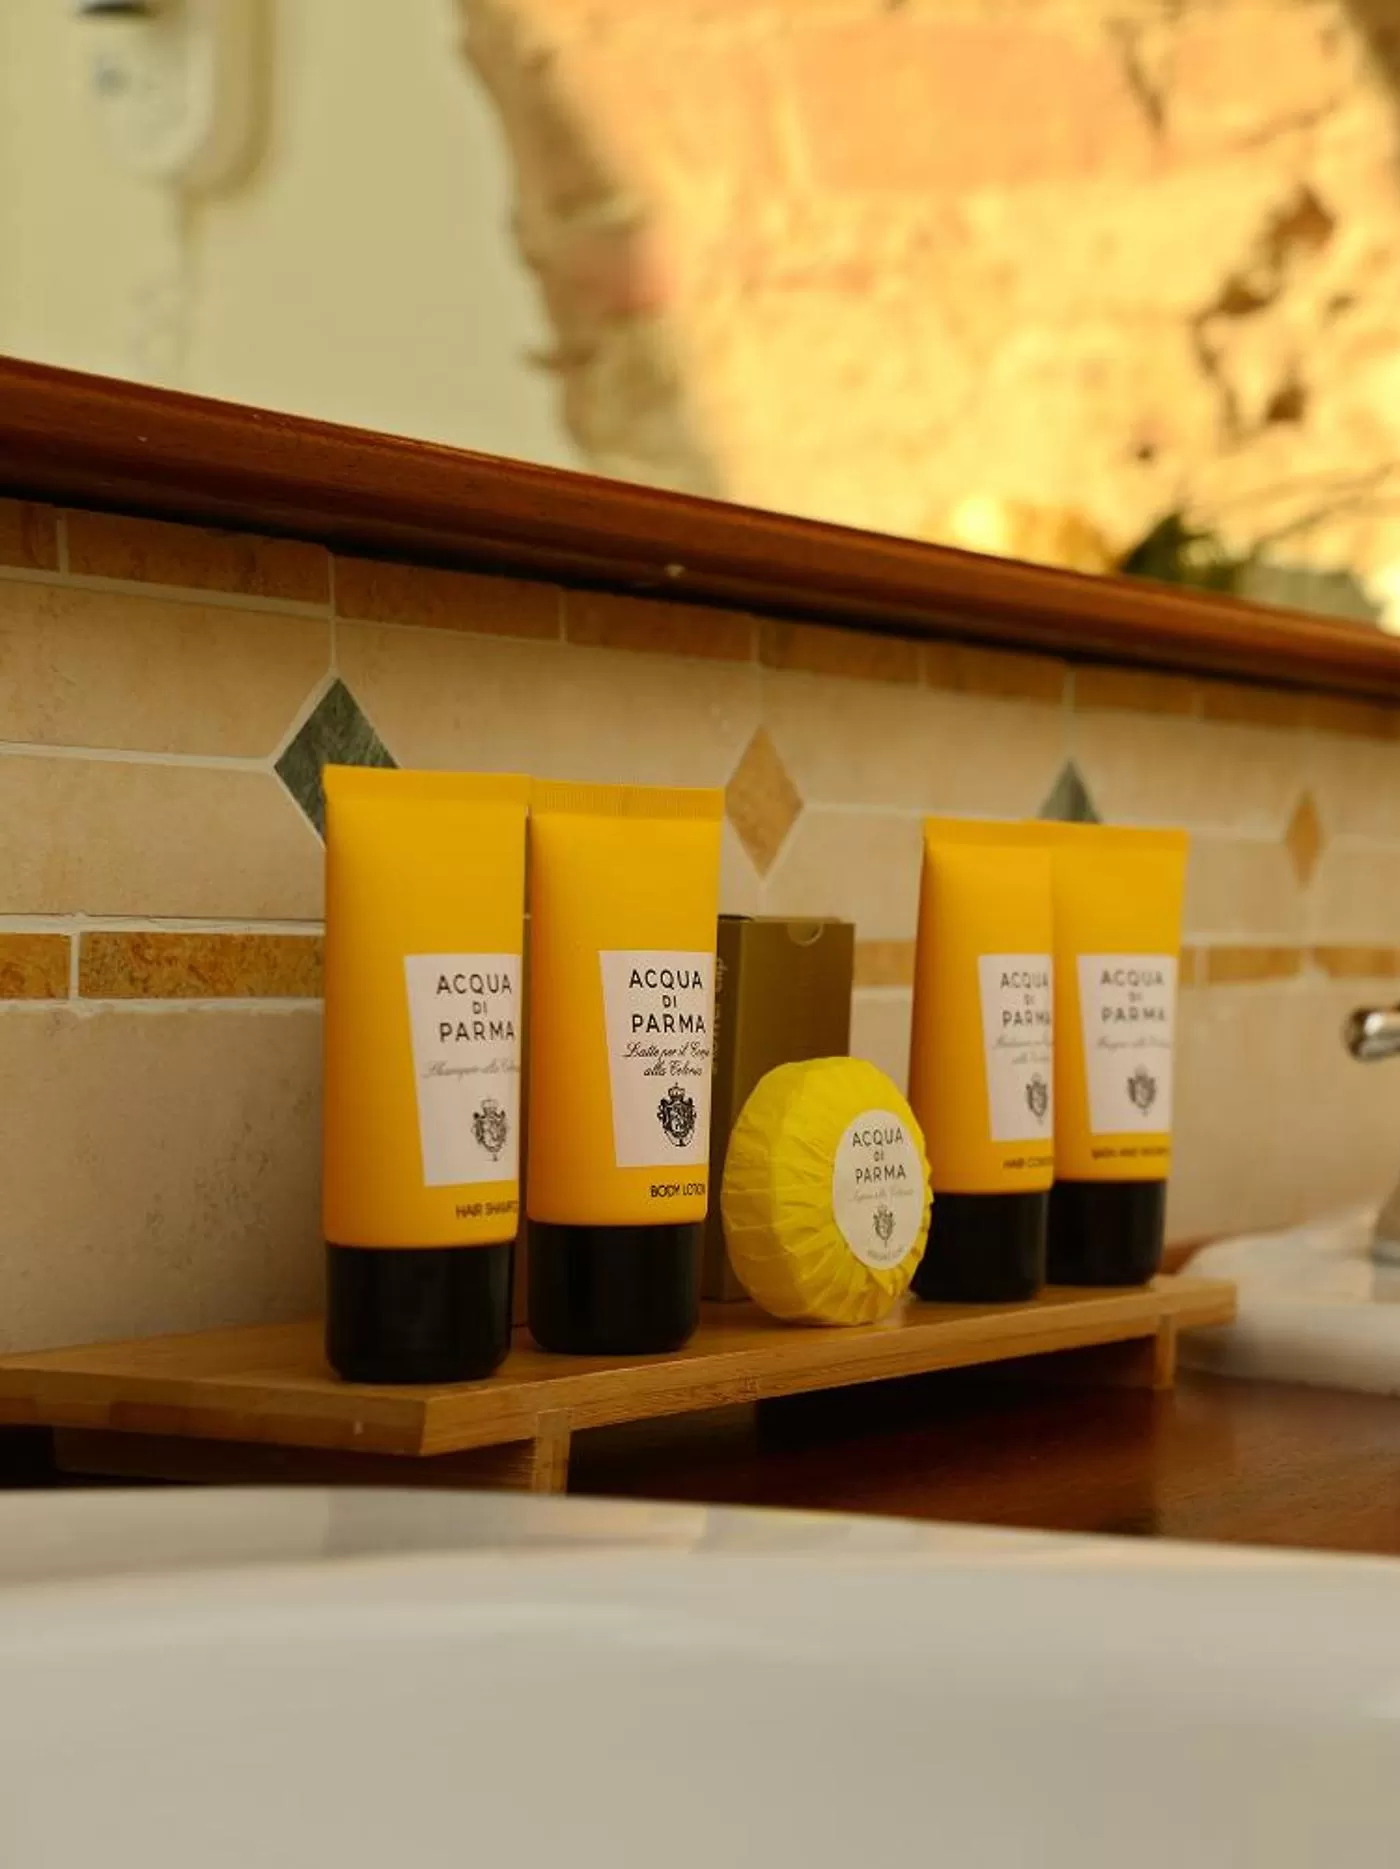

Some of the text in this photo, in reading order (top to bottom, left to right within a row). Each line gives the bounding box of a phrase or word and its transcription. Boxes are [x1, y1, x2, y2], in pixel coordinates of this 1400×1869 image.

[436, 973, 513, 995] ACQUA
[629, 969, 703, 989] ACQUA
[1000, 972, 1049, 989] ACQUA
[1101, 969, 1165, 987] ACQUA
[472, 1001, 488, 1015] DI
[662, 995, 677, 1008] DI
[631, 1013, 707, 1034] PARMA
[1002, 1010, 1052, 1028] PARMA
[1101, 1006, 1166, 1023] PARMA
[439, 1020, 516, 1042] PARMA
[852, 1127, 904, 1148] ACQUA
[874, 1151, 885, 1162] DI
[855, 1164, 907, 1184] PARMA
[650, 1184, 681, 1198] BODY
[455, 1202, 482, 1219] HAIR
